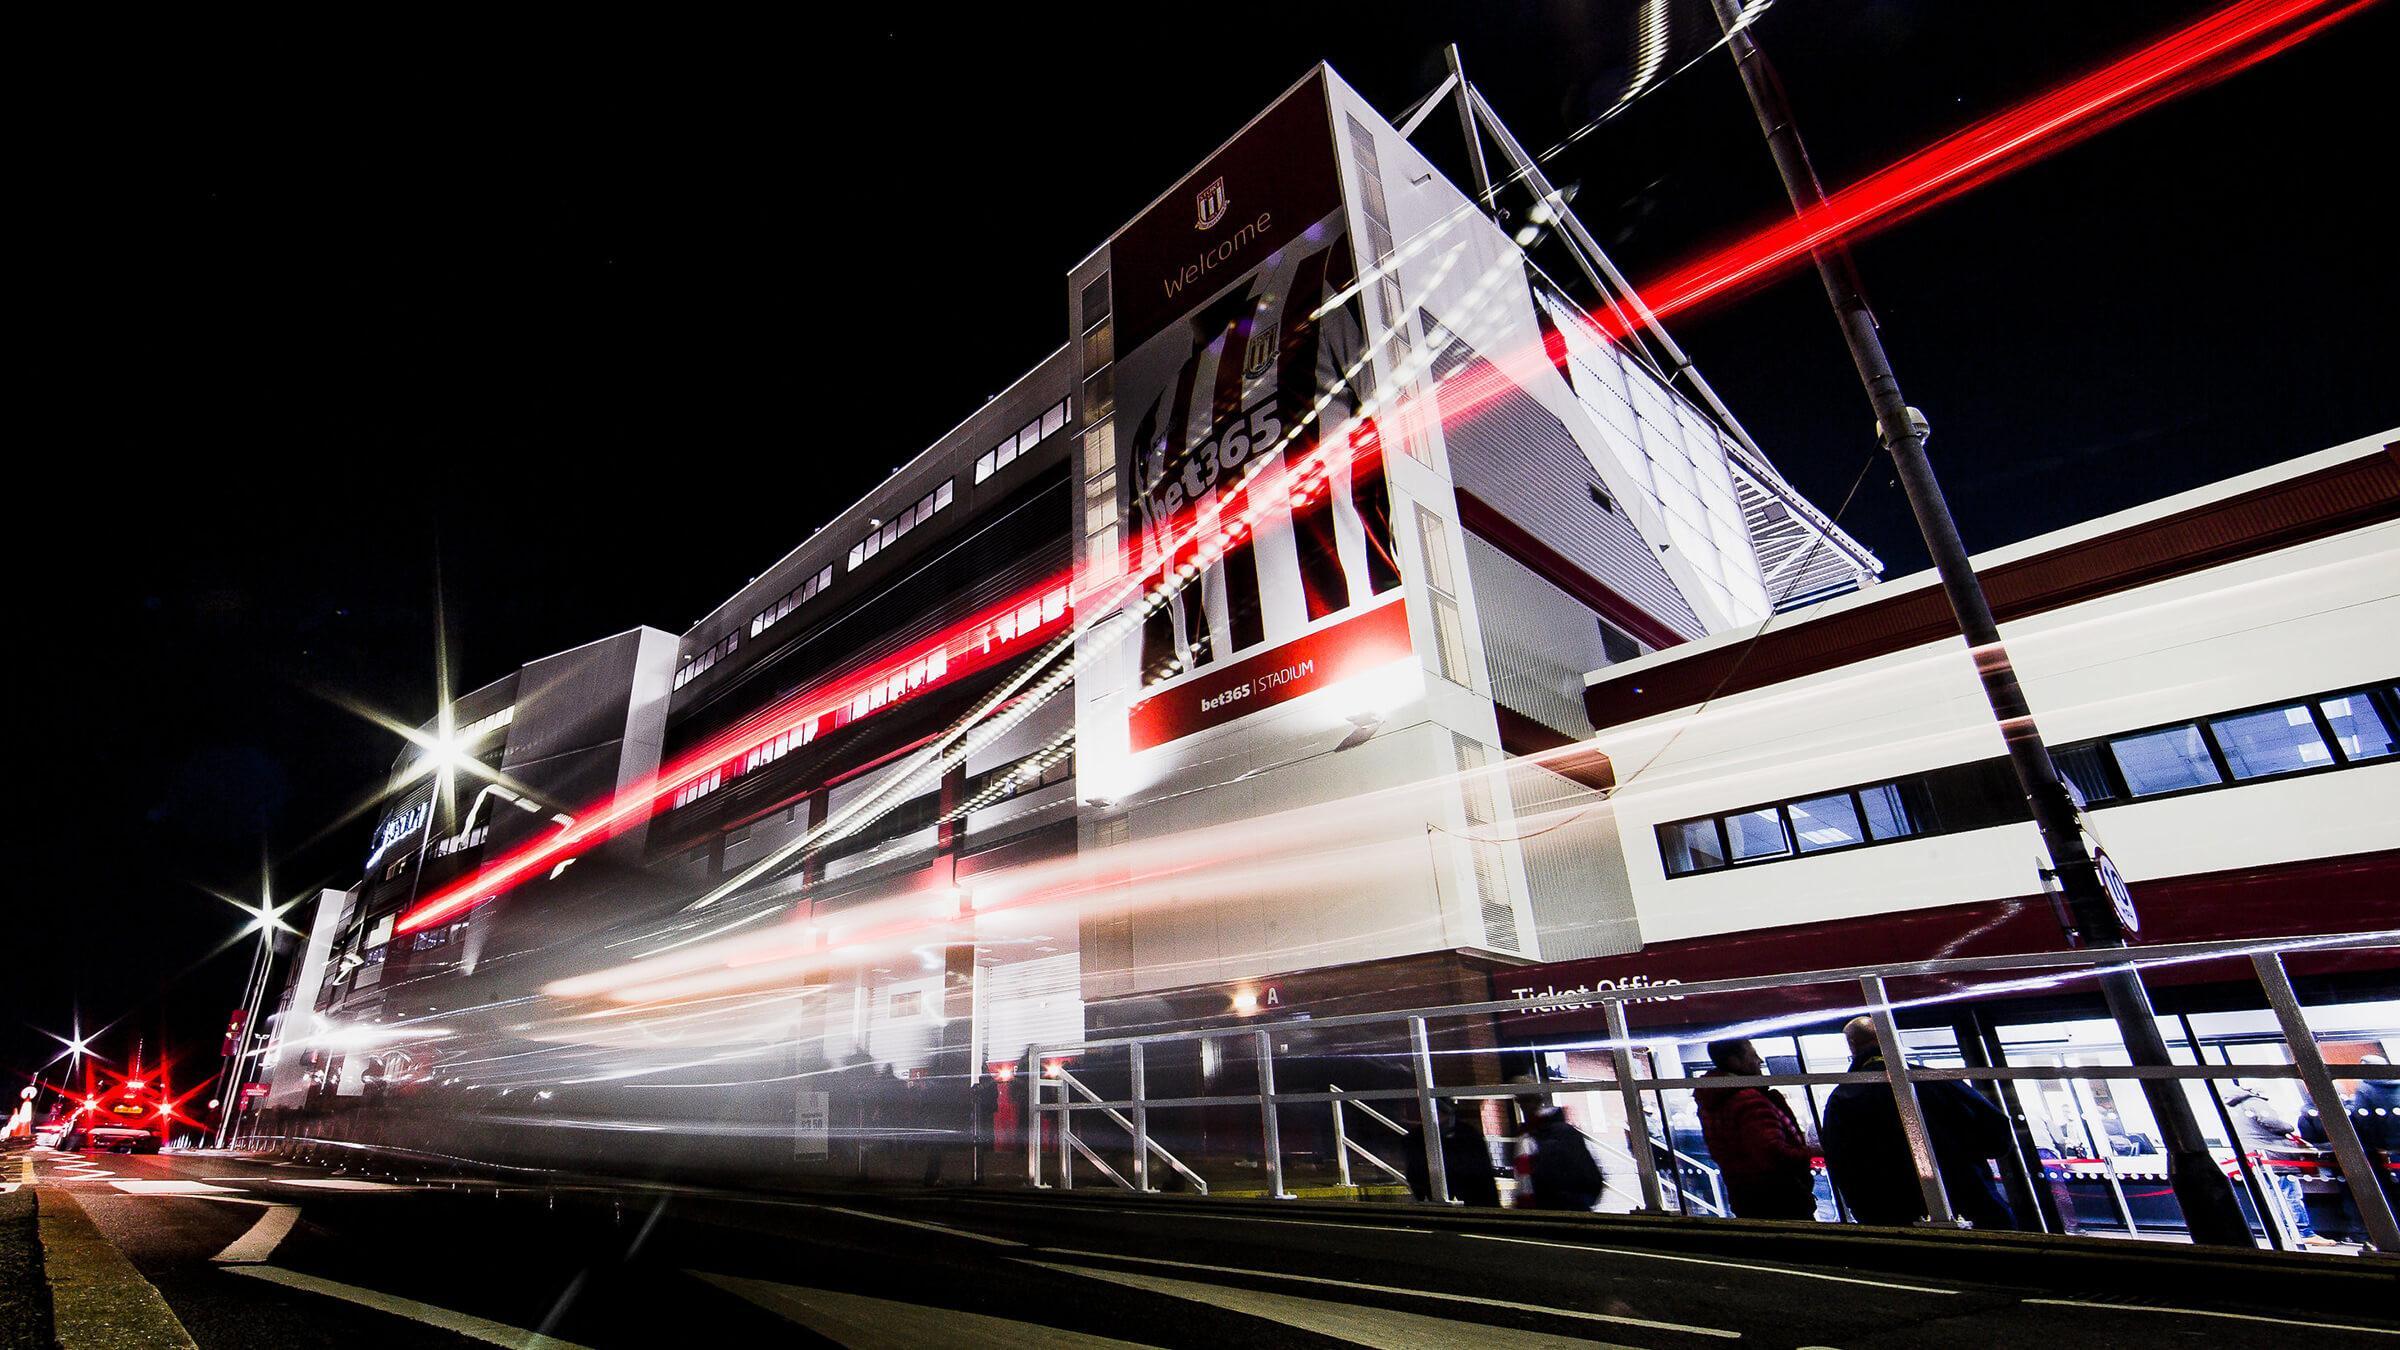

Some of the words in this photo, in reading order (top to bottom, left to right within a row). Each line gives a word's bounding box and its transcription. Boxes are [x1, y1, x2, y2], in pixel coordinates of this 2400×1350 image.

[1164, 220, 1272, 298] Welcome
[1201, 683, 1250, 712] bet365
[1258, 659, 1314, 692] STADIUM
[2104, 866, 2129, 906] 10
[1267, 987, 1279, 1005] A
